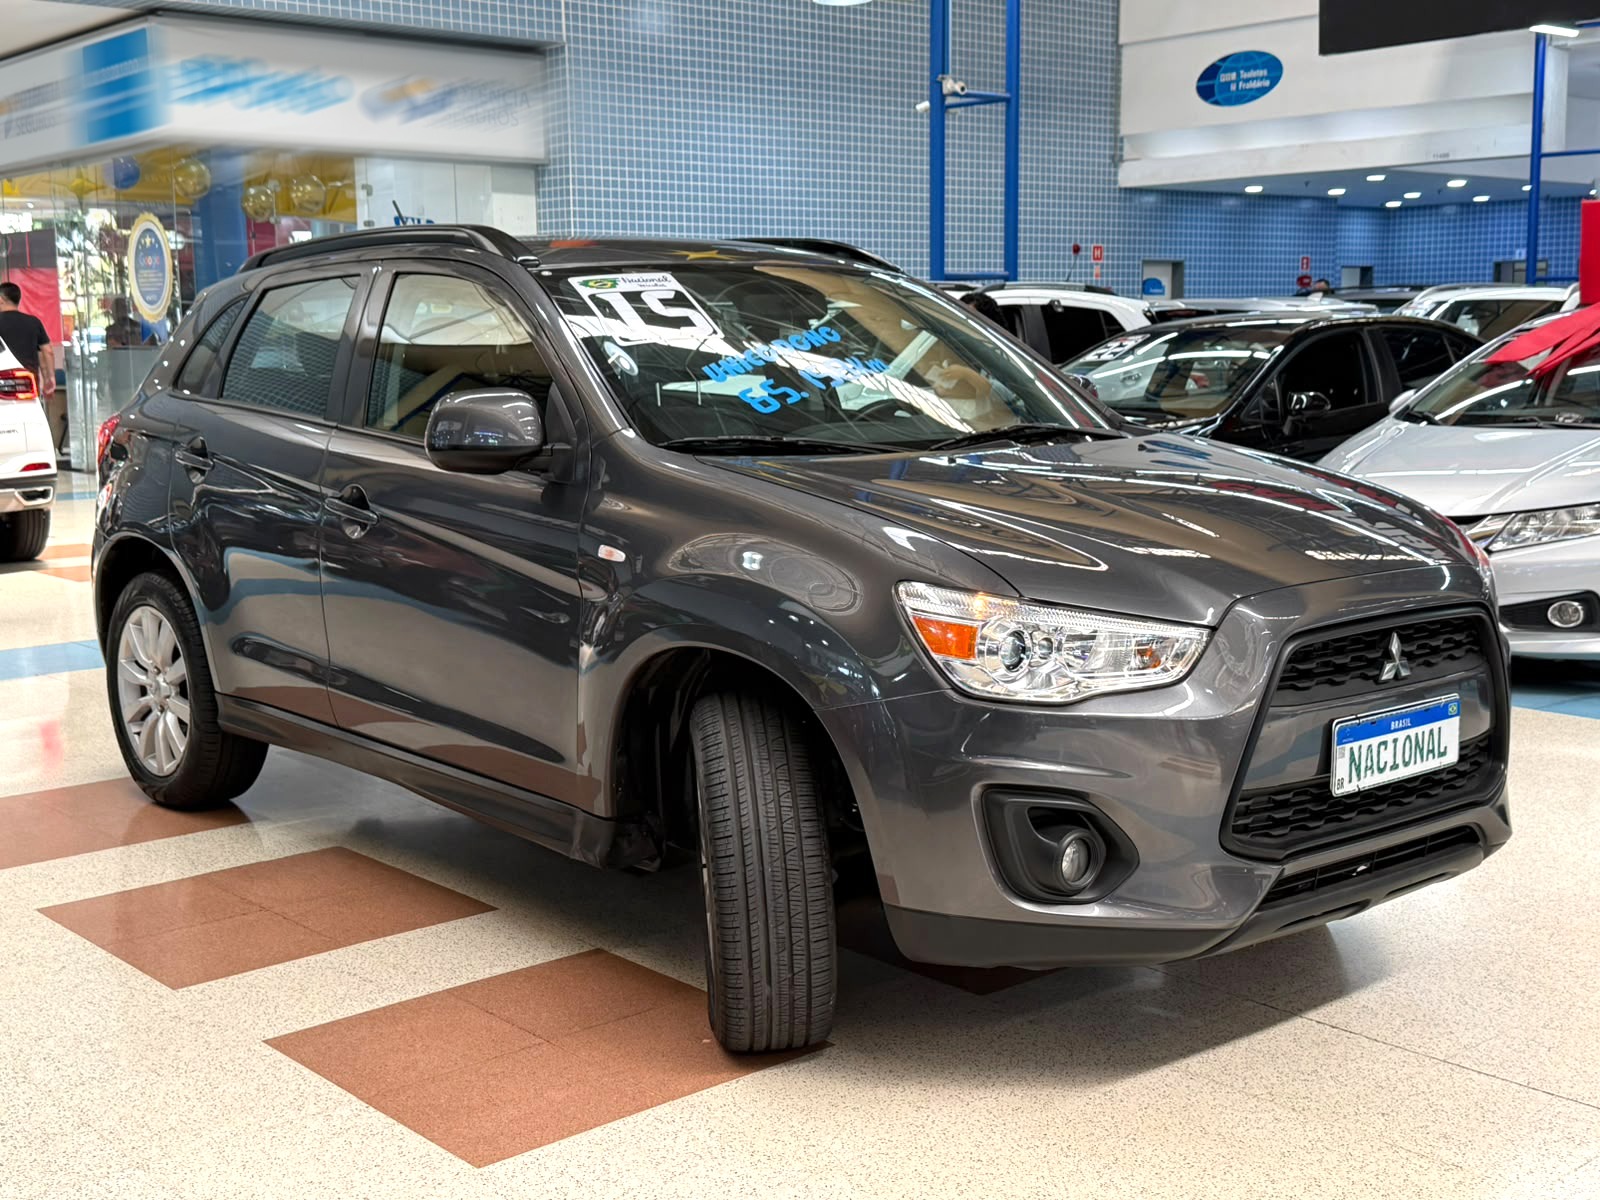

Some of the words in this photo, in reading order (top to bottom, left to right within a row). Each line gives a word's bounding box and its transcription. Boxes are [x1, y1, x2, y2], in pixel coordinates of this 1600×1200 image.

[595, 289, 714, 340] 15
[1390, 717, 1412, 730] BRASIL
[1348, 726, 1448, 784] NACIONAL
[1336, 778, 1345, 790] BR
